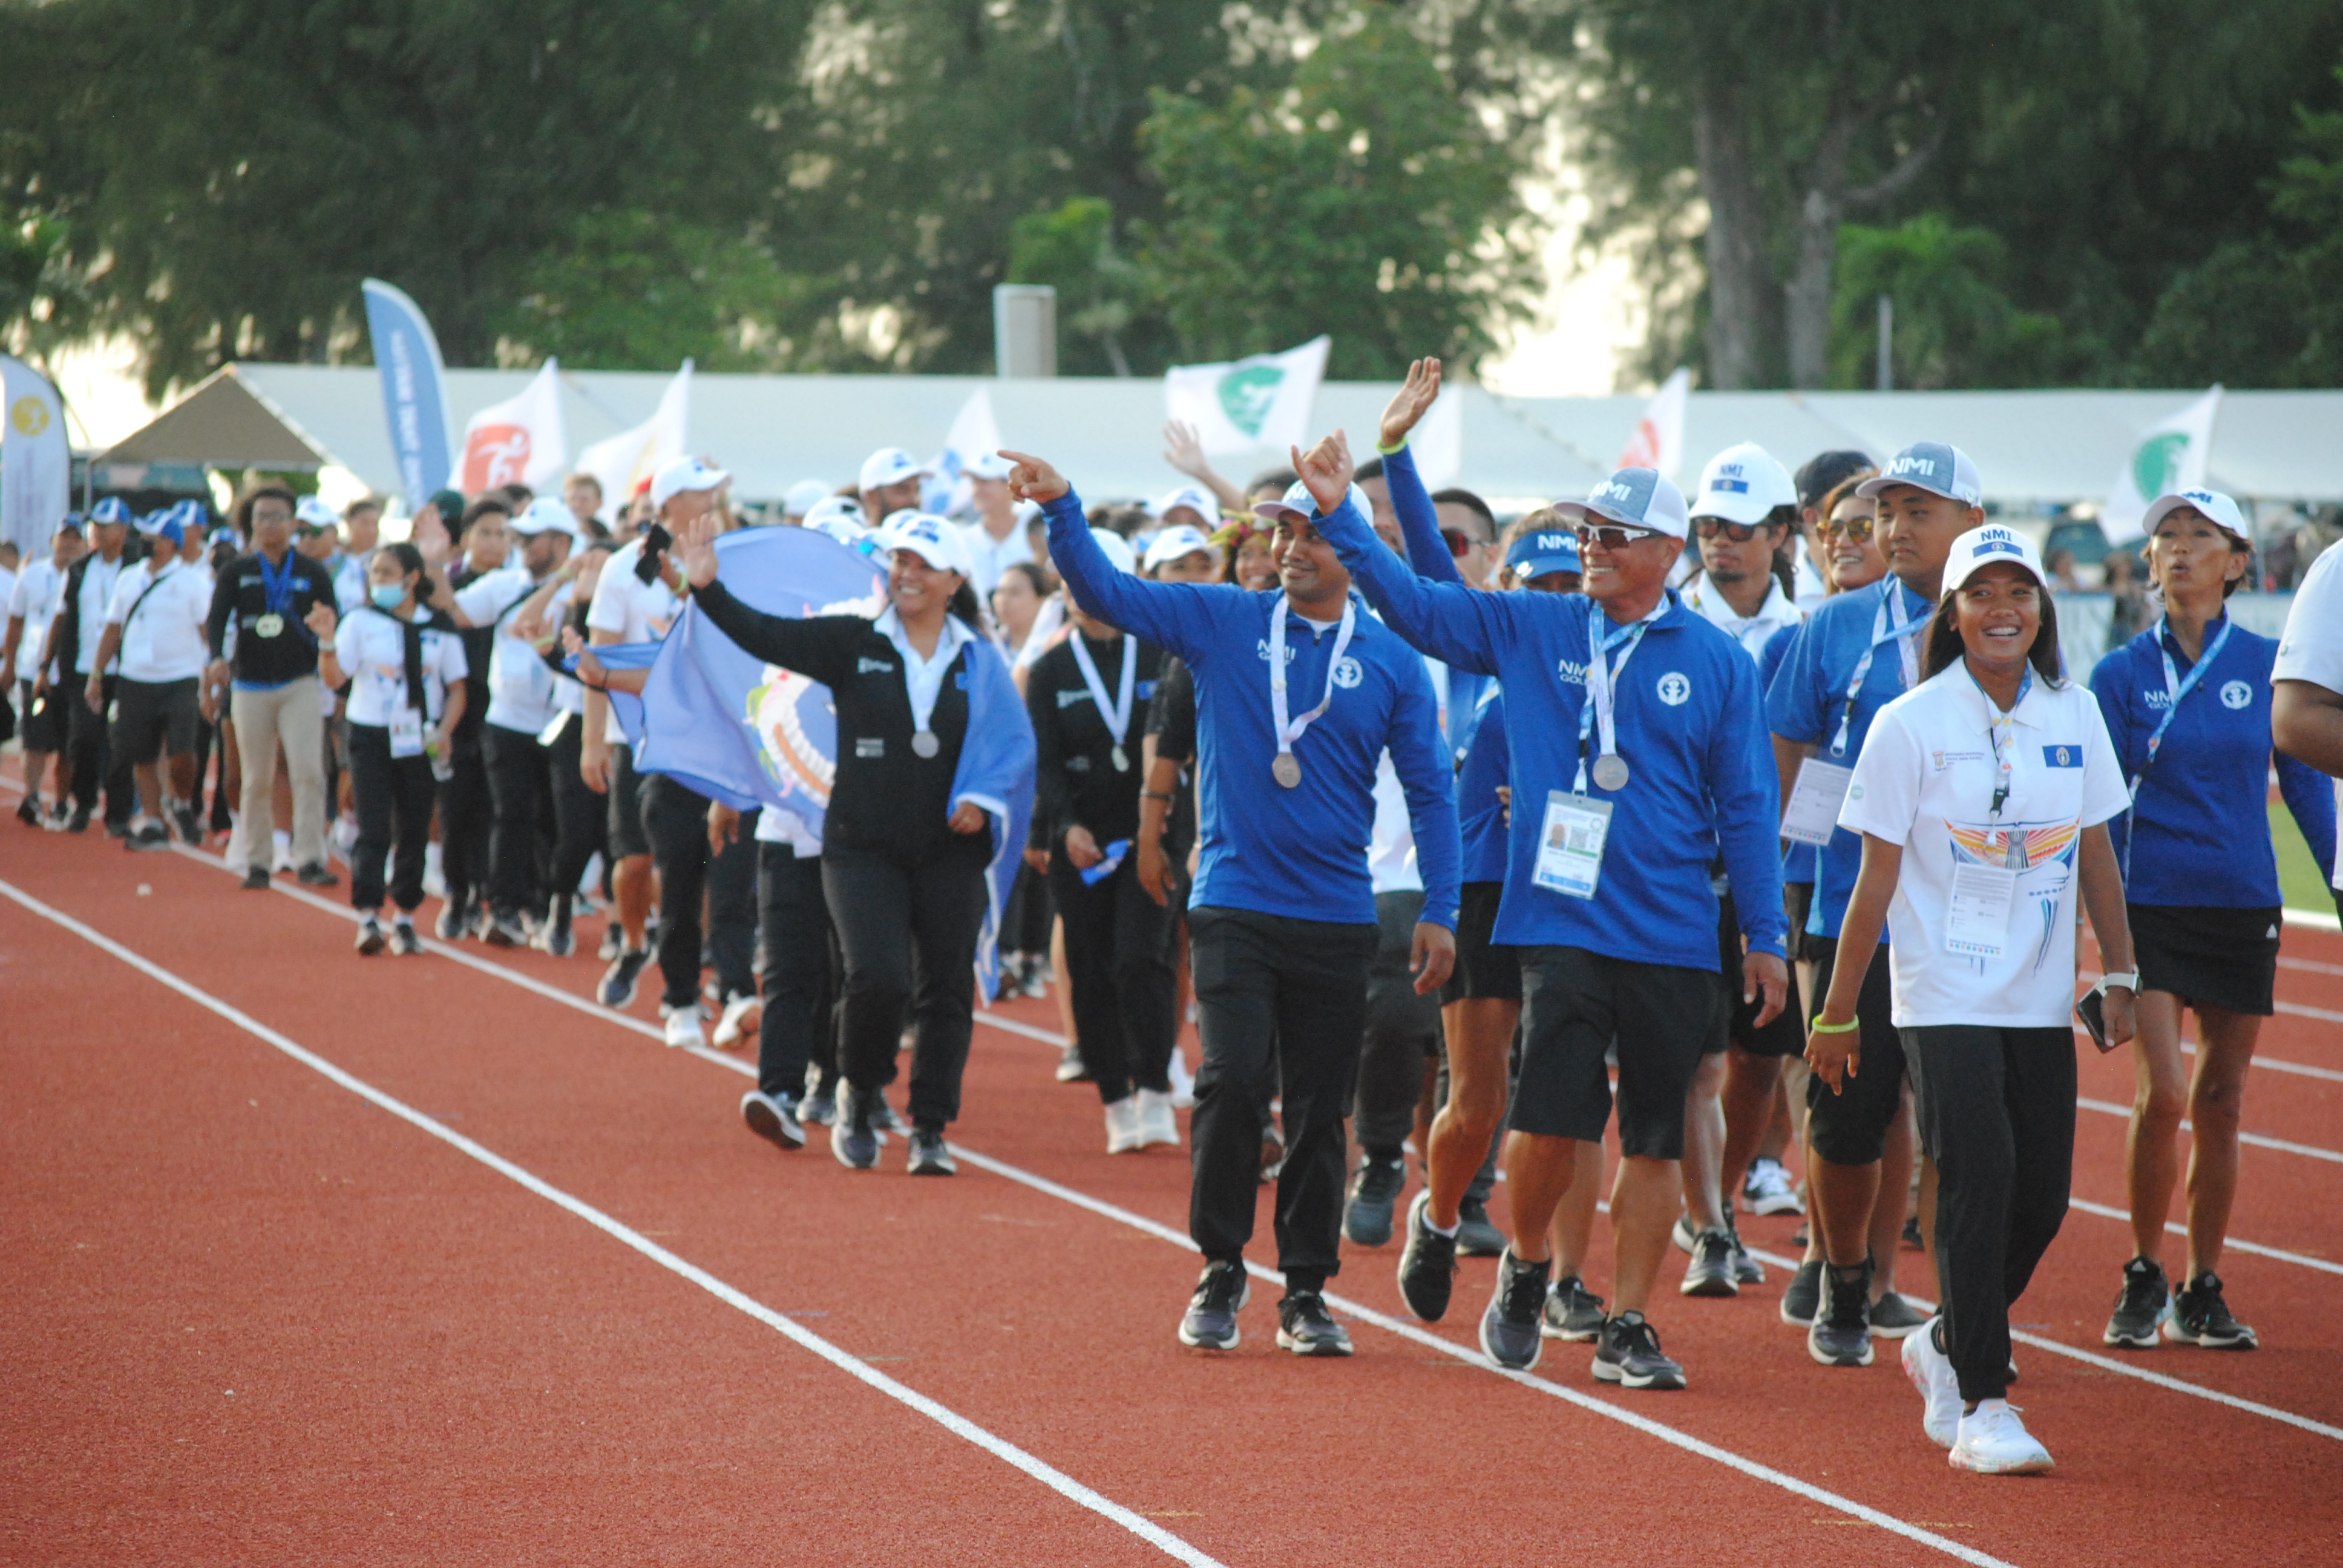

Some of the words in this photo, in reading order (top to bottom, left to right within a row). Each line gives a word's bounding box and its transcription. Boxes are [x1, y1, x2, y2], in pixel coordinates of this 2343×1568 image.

[1720, 464, 1744, 477] NMI
[1884, 457, 1935, 477] NMI
[1587, 481, 1632, 502] NMI
[1538, 535, 1576, 550] NMI
[1981, 529, 2012, 542] NMI
[1257, 639, 1296, 661] NI
[1559, 659, 1588, 676] NM
[1560, 673, 1586, 686] GOL
[2144, 690, 2171, 702] NM
